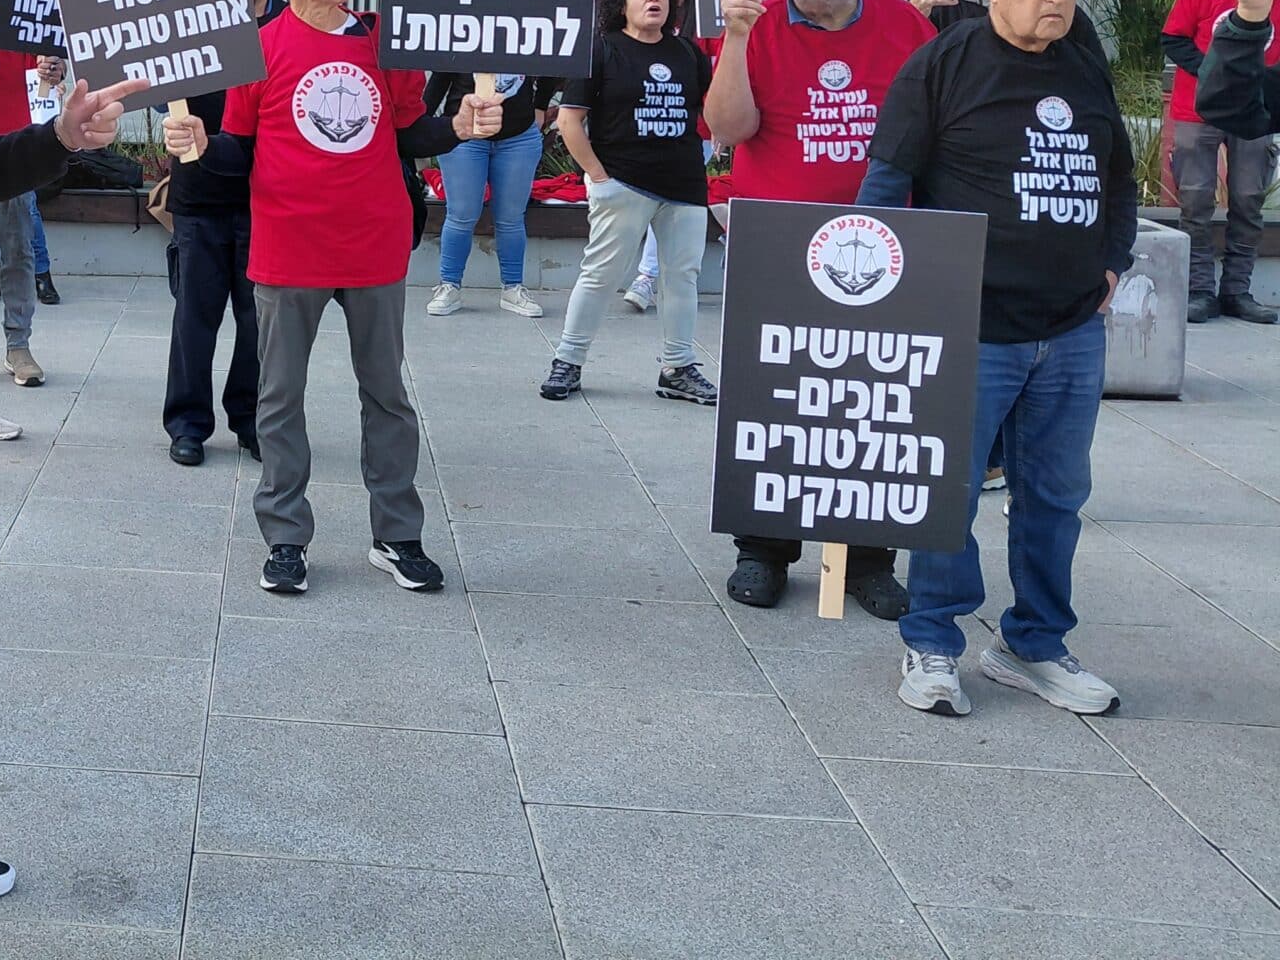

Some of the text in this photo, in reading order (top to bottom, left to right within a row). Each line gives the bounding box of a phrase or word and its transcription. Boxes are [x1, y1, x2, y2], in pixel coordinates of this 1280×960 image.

[10, 15, 67, 47] דינה"
[70, 13, 170, 62] טובעים
[391, 6, 581, 57] לתרופות!
[123, 44, 223, 87] בחובות
[296, 65, 380, 124] עמותת נפגעי סלייס
[807, 87, 867, 104] עמית גל
[842, 104, 877, 122] הזמן
[797, 122, 876, 140] שת ביטחון
[803, 138, 871, 163] כשיו!
[1025, 127, 1089, 151] עמית גל
[1013, 172, 1101, 193] רשת ביטחון
[1064, 153, 1096, 174] הזמן
[1020, 191, 1099, 227] עכשיו!
[811, 218, 901, 276] עמותת נפגעי סלייס
[760, 323, 944, 387] קשישים
[773, 376, 913, 424] בוכים-
[735, 419, 945, 476] רגולטורים
[754, 471, 930, 528] שותקים
